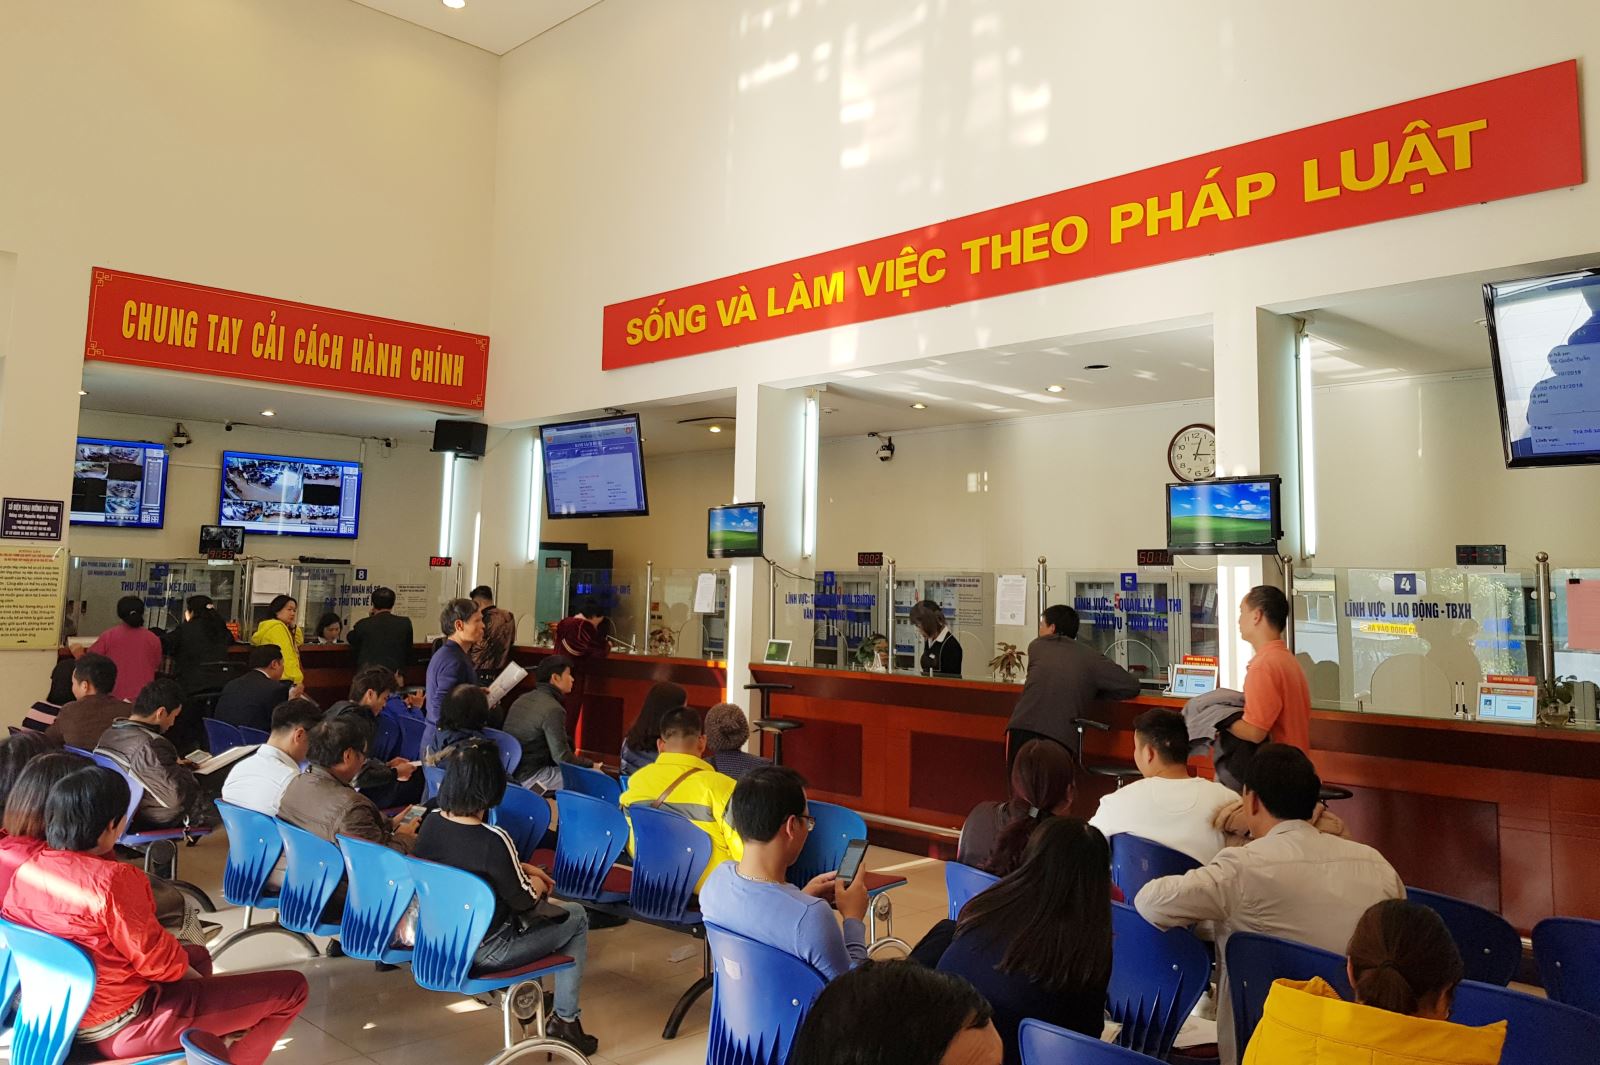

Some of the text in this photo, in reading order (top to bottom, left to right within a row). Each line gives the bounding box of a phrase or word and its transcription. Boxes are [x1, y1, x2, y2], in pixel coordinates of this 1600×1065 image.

[626, 118, 1488, 346] SỐNG VÀ LÀM VIỆC THEO PHÁP LUẬT
[122, 299, 465, 387] CHUNG TAY CẢI CÁCH HÀNH CHÍNH
[358, 570, 365, 580] 8
[1125, 576, 1133, 588] 5
[1400, 577, 1411, 591] 4
[1345, 599, 1366, 617] LĨNH
[1367, 601, 1387, 621] VỰC
[1391, 602, 1410, 618] LAO
[1412, 599, 1439, 622] ĐỘNG
[1446, 602, 1472, 620] TBXH
